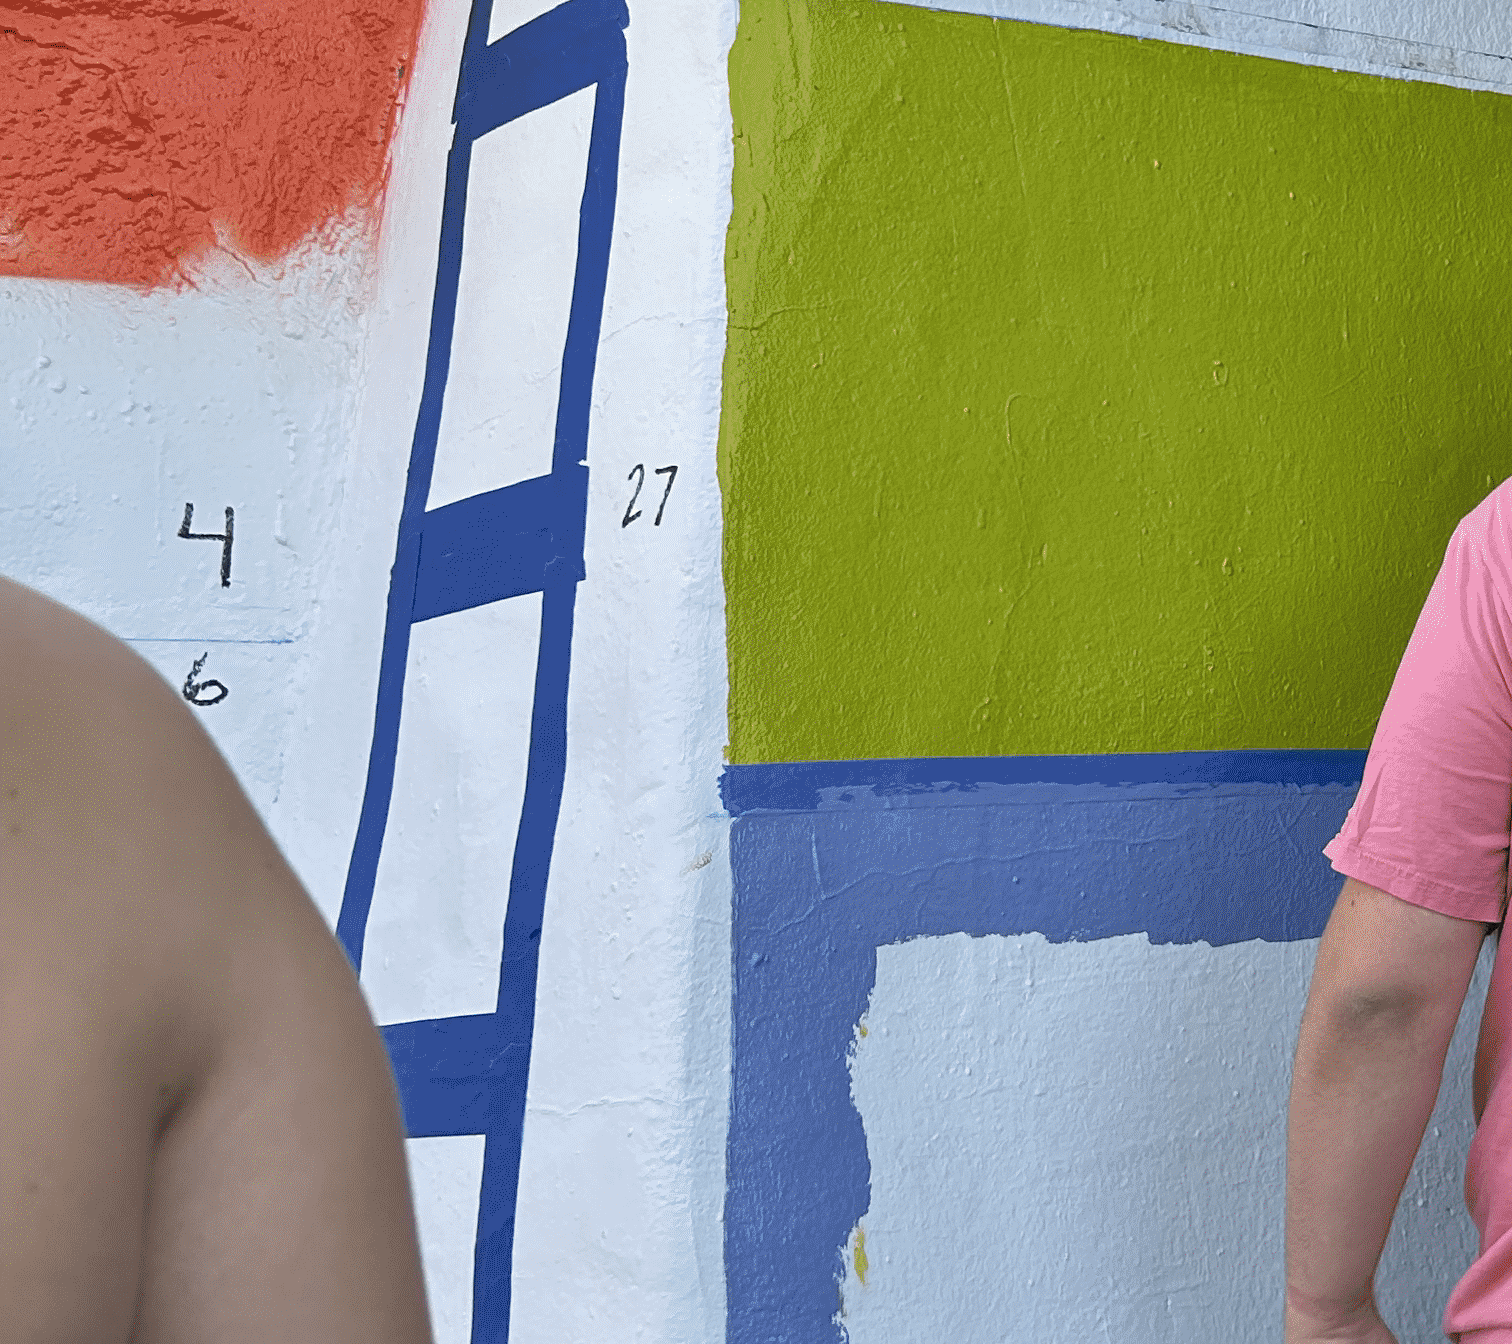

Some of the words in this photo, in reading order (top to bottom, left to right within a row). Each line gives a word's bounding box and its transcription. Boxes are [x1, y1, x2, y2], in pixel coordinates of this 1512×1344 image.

[621, 464, 679, 528] 27
[177, 502, 235, 588] 4
[182, 652, 228, 706] 6
